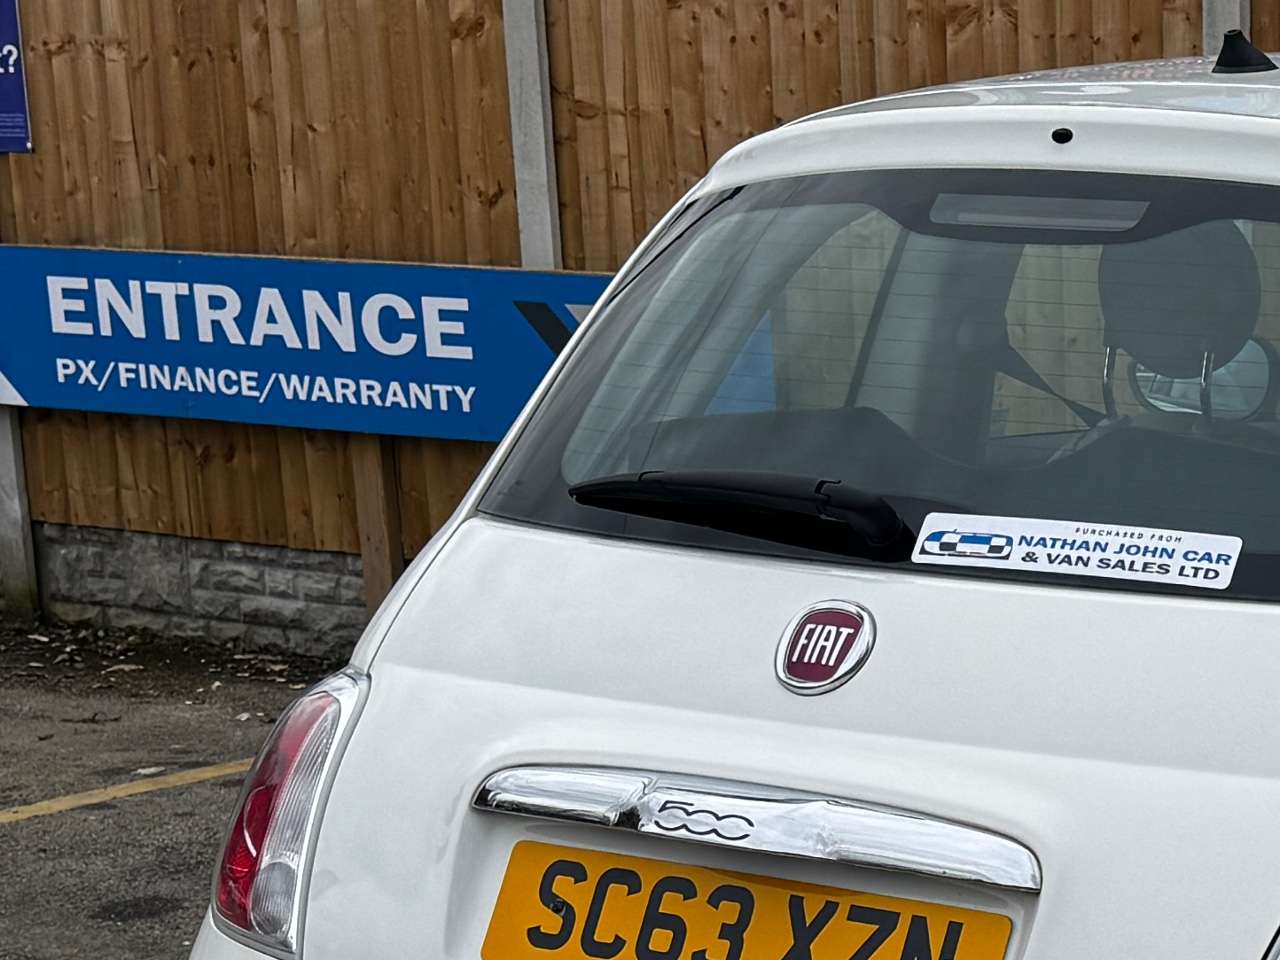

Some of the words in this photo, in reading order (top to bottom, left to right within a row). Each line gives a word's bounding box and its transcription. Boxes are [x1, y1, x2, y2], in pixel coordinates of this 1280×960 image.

[46, 275, 473, 360] ENTRANCE
[56, 358, 476, 413] PX/FINANCE/WARRANTY
[1018, 535, 1109, 553] NATHAN
[1113, 543, 1175, 560] JOHN
[1182, 550, 1233, 566] CAR
[1075, 527, 1144, 540] PURCHASED
[1150, 534, 1183, 543] FROM
[1021, 551, 1038, 563] &
[1046, 553, 1091, 568] VAN
[1097, 557, 1171, 575] SALES
[1178, 565, 1221, 580] LTD
[791, 623, 855, 667] FIAT
[654, 800, 755, 841] 500
